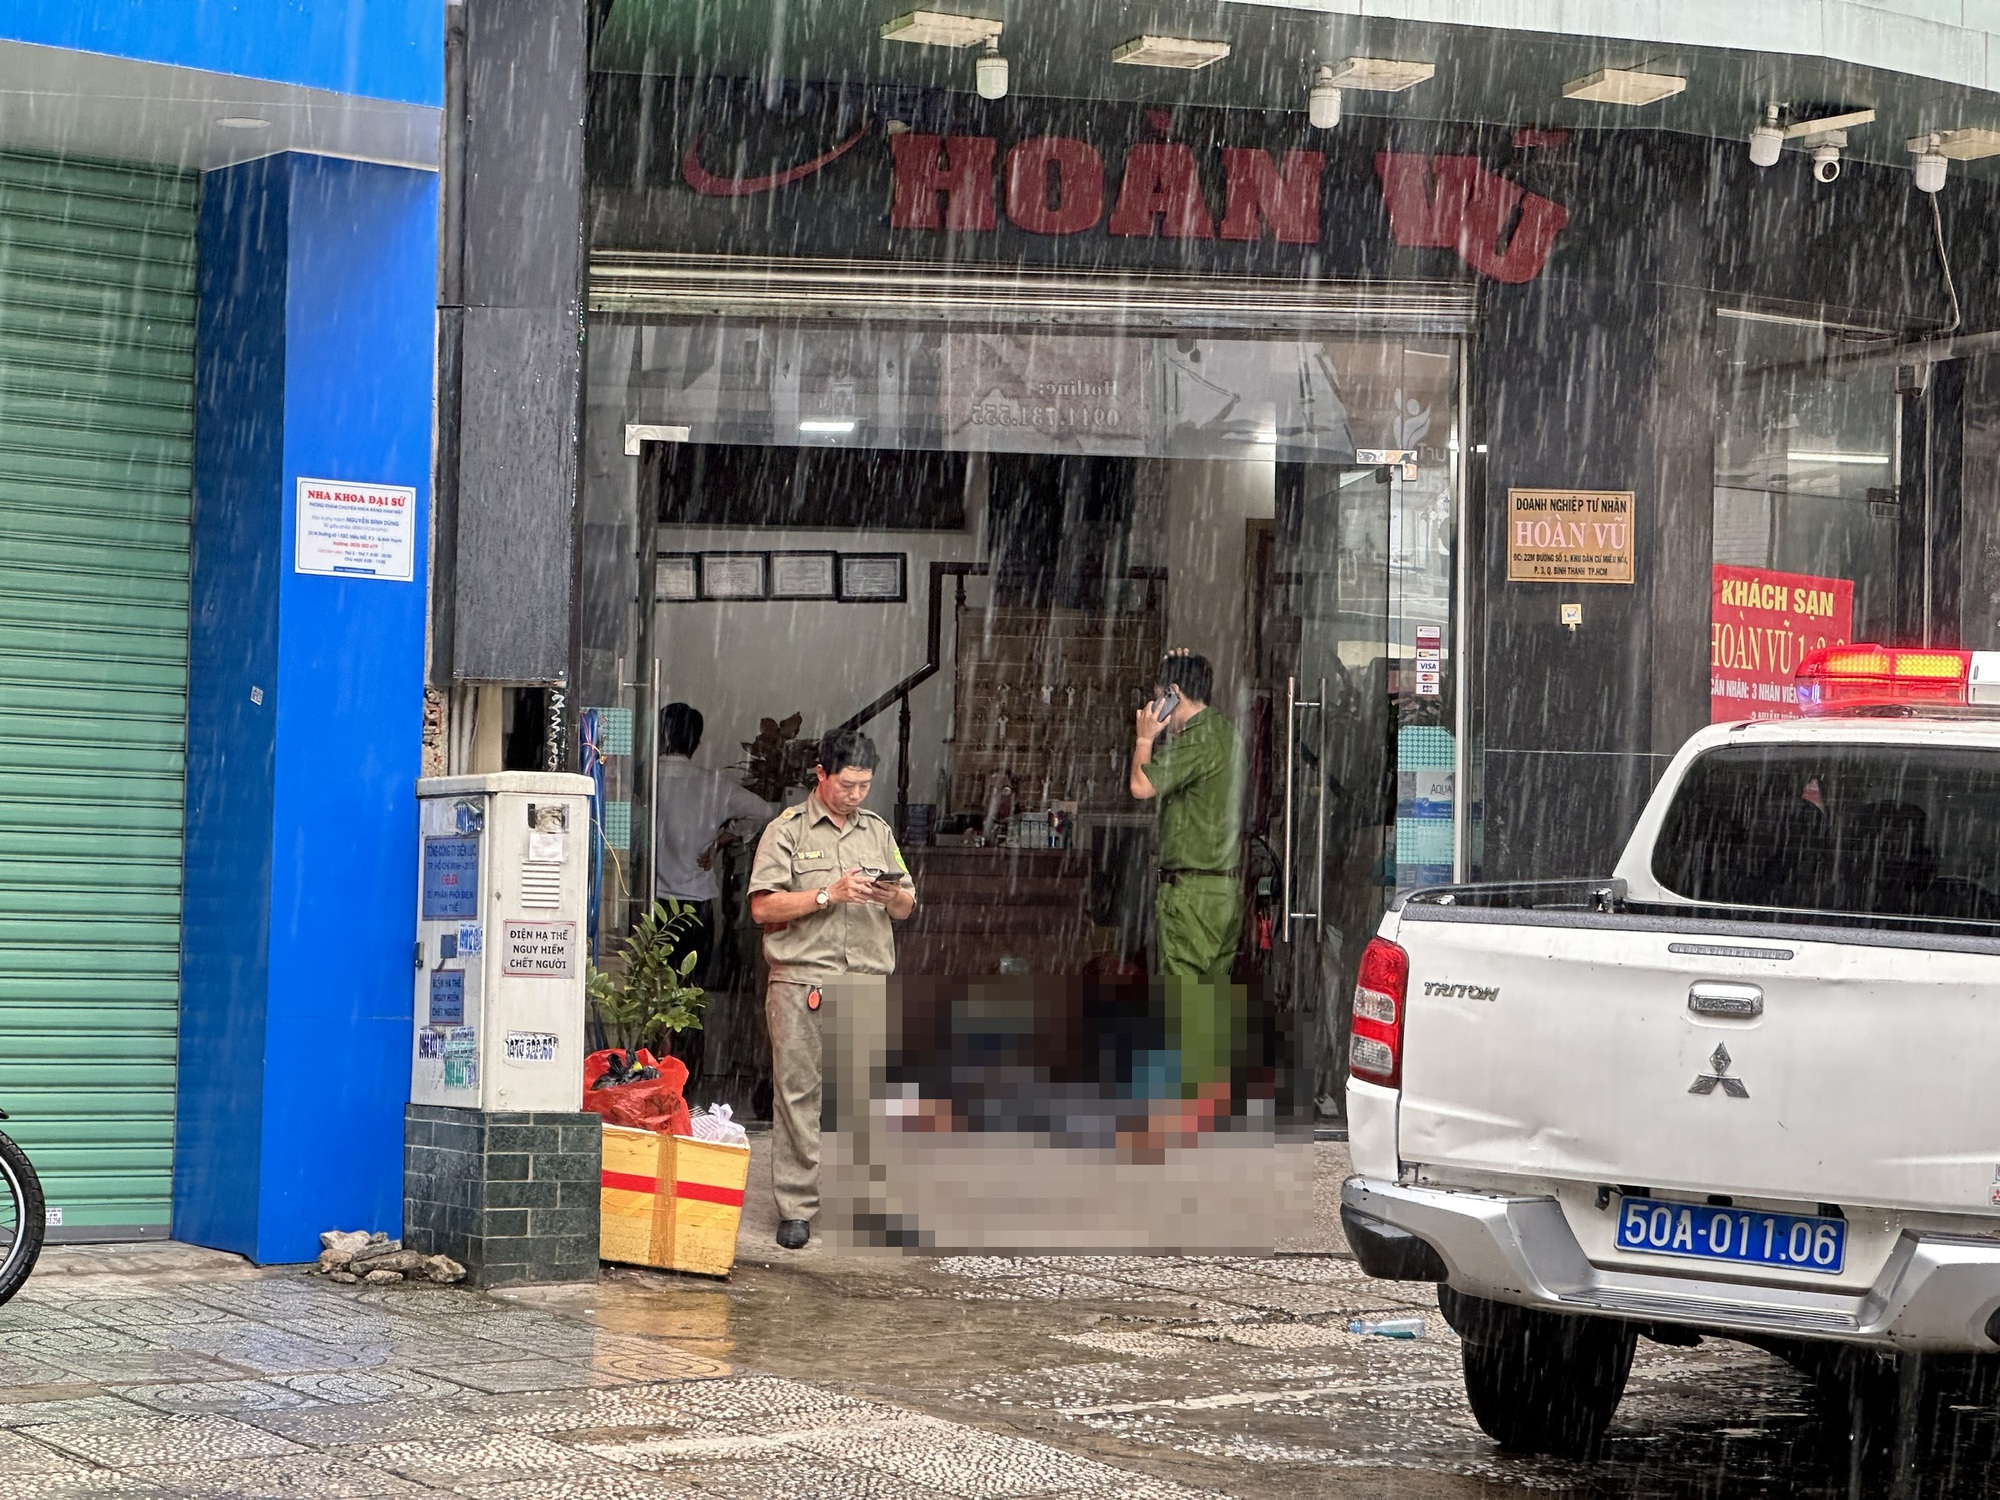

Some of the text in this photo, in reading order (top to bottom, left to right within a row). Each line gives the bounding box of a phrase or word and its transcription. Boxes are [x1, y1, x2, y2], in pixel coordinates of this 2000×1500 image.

[891, 110, 1326, 244] HOÀN
[308, 490, 331, 500] NHA
[334, 492, 365, 503] KHOA
[368, 496, 389, 507] ĐẠI
[1516, 496, 1627, 514] DOANH NGHIỆP TƯ NHÂN
[1515, 513, 1627, 550] HOÀN VŨ
[1721, 578, 1834, 620] KHÁCH SẠN
[1766, 619, 1793, 675] VŨ
[1752, 683, 1757, 700] 3
[1759, 681, 1780, 702] NHÂN
[1430, 783, 1452, 795] AQUA
[510, 928, 533, 941] ĐIỆN
[536, 931, 548, 942] HẠ
[513, 945, 538, 954] NGUY
[536, 958, 567, 969] NGƯỜI
[1424, 982, 1500, 1002] TRITON
[1624, 1204, 1837, 1265] 50A-011.06
